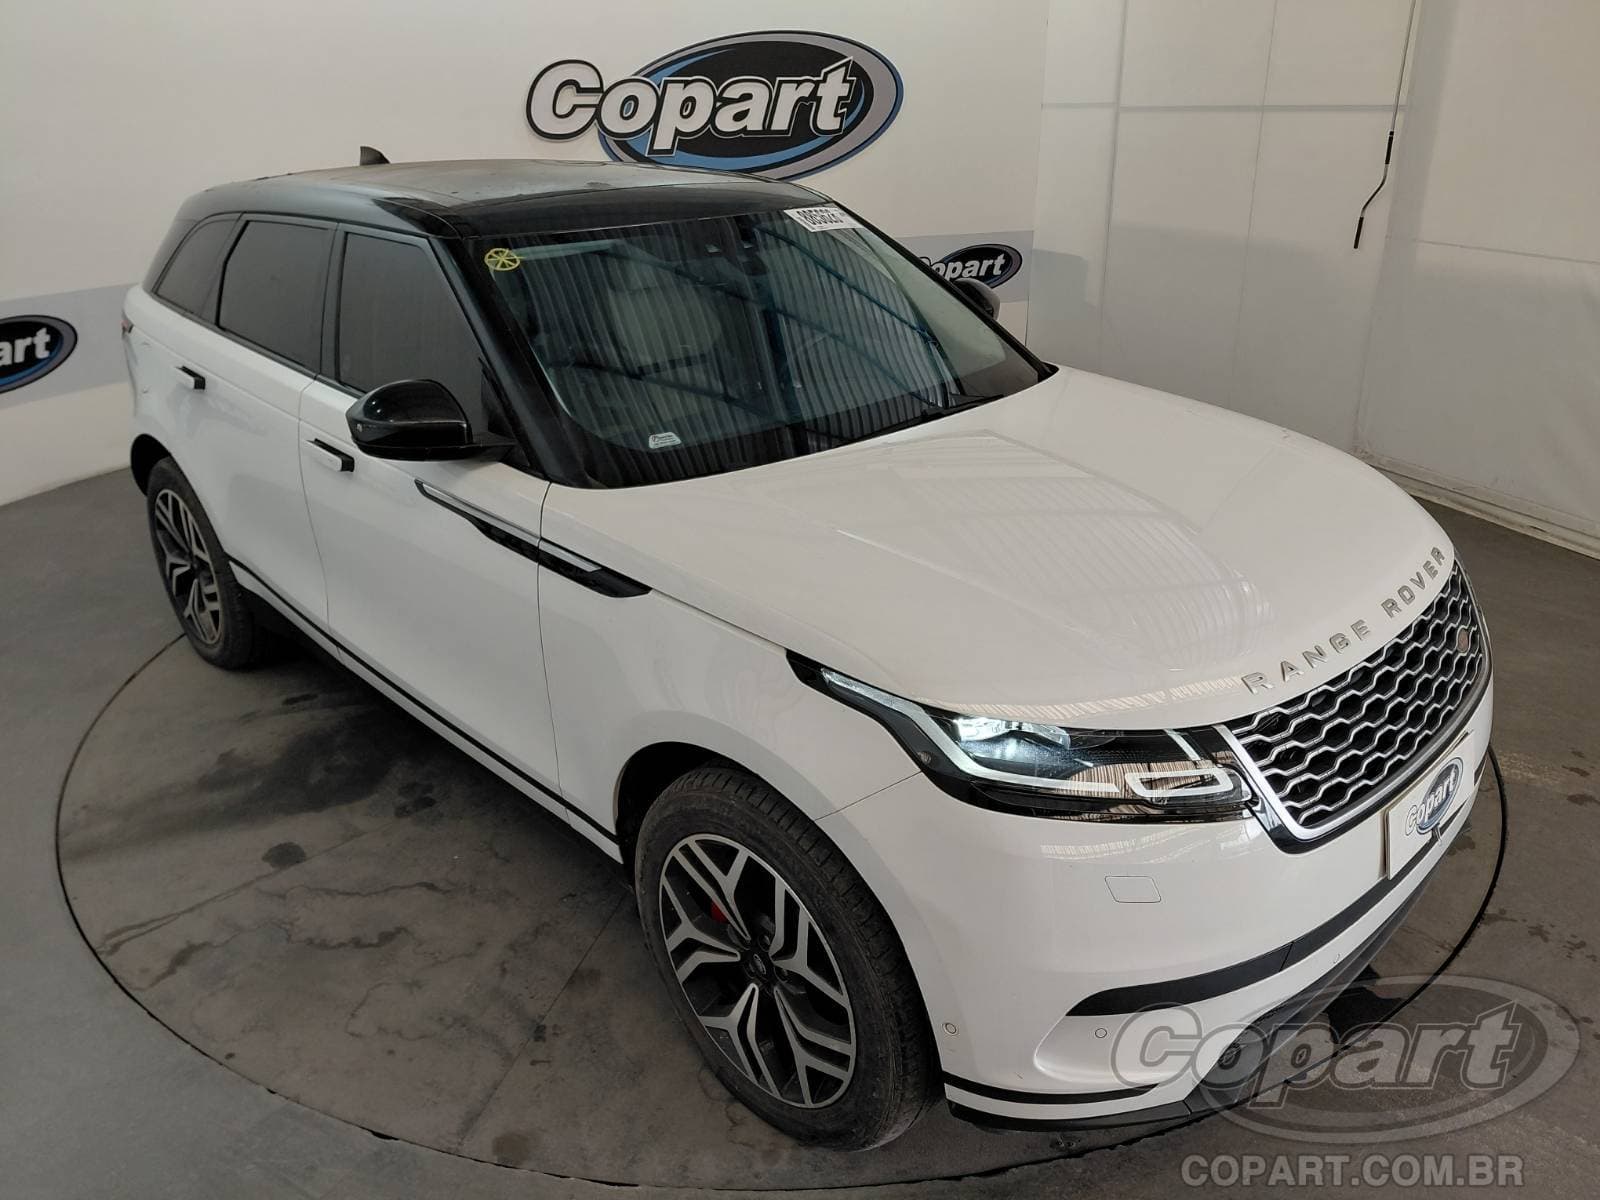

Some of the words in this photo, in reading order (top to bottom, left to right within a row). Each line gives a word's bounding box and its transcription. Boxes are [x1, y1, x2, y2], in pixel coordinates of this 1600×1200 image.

[526, 59, 854, 157] Copart
[920, 254, 1006, 281] opart
[1241, 619, 1372, 695] RANGE
[1381, 546, 1446, 618] ROVER
[1405, 764, 1457, 836] Copart
